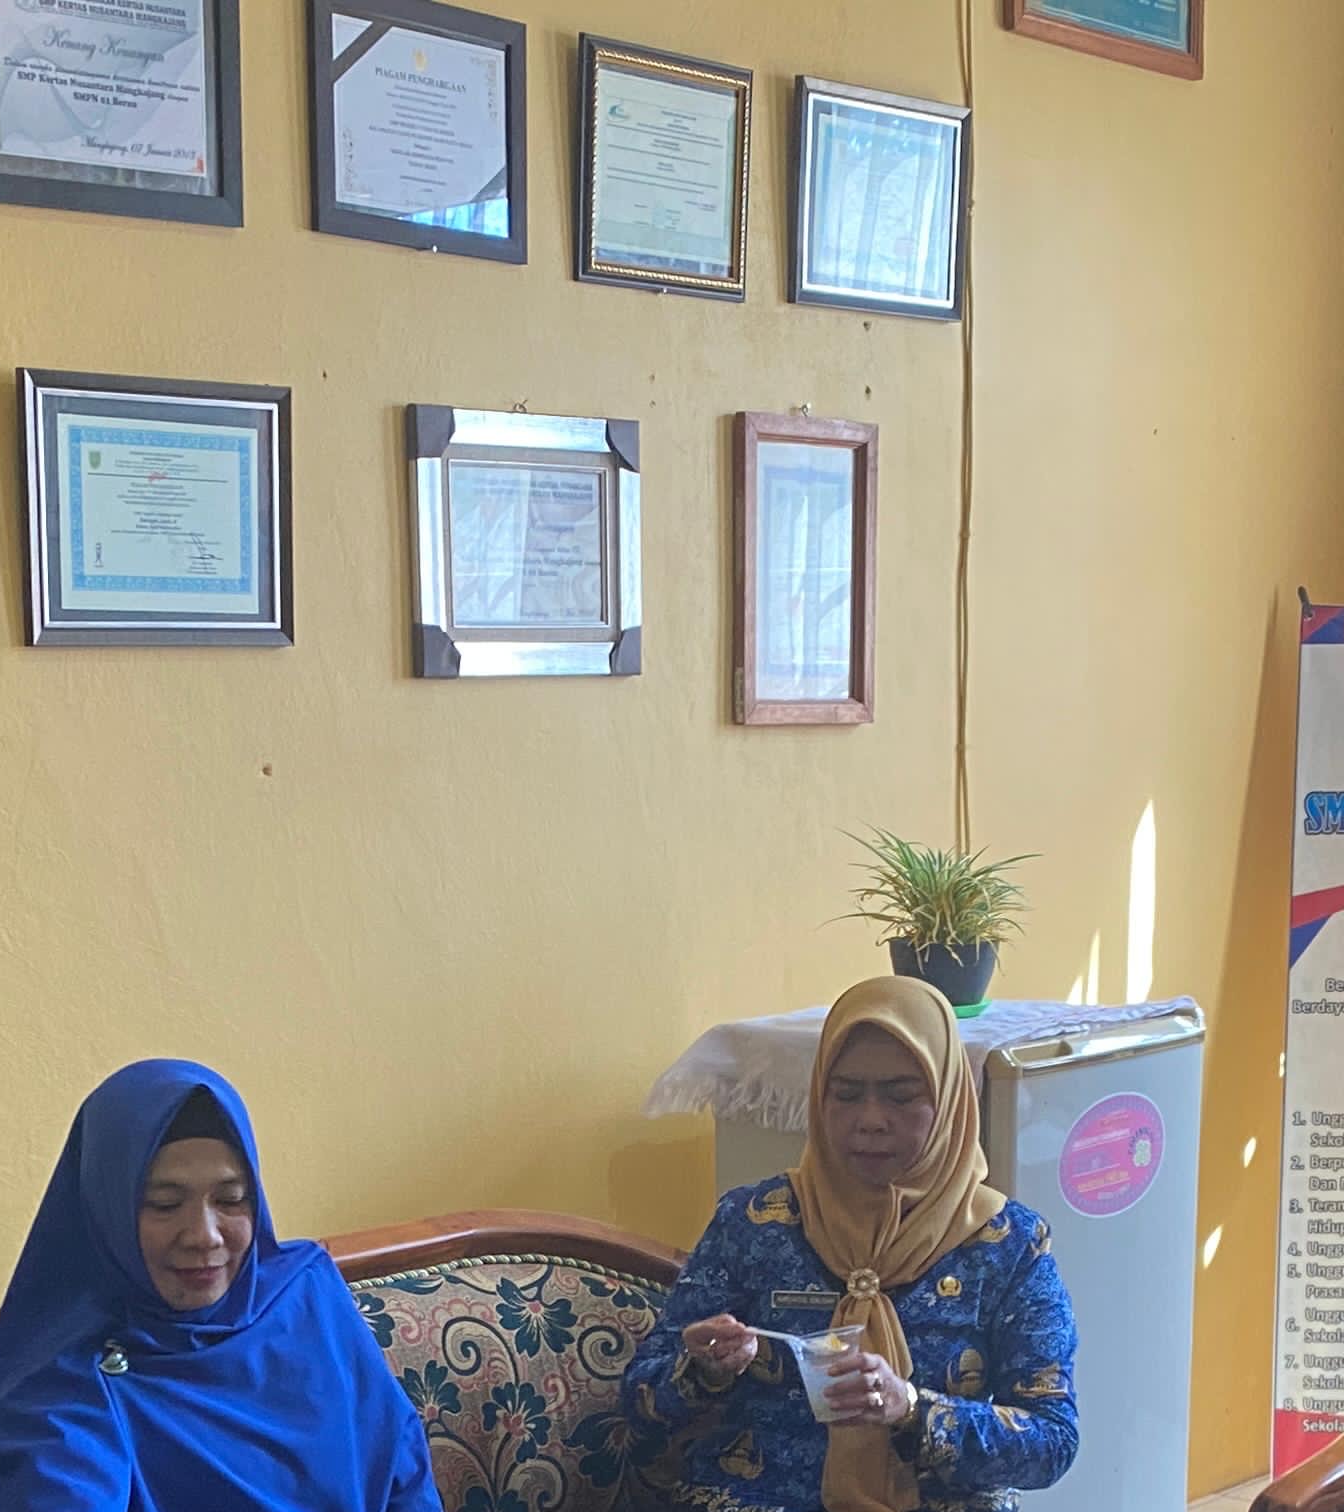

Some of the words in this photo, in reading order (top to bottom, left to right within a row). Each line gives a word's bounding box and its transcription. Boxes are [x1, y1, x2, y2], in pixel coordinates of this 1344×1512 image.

[1292, 1113, 1307, 1127] 1.
[1290, 1156, 1305, 1171] 2.
[1309, 1177, 1338, 1191] Dan
[1289, 1201, 1304, 1215] 3.
[1287, 1243, 1302, 1257] 4.
[1287, 1264, 1302, 1278] 5.
[1284, 1354, 1299, 1369] 7.
